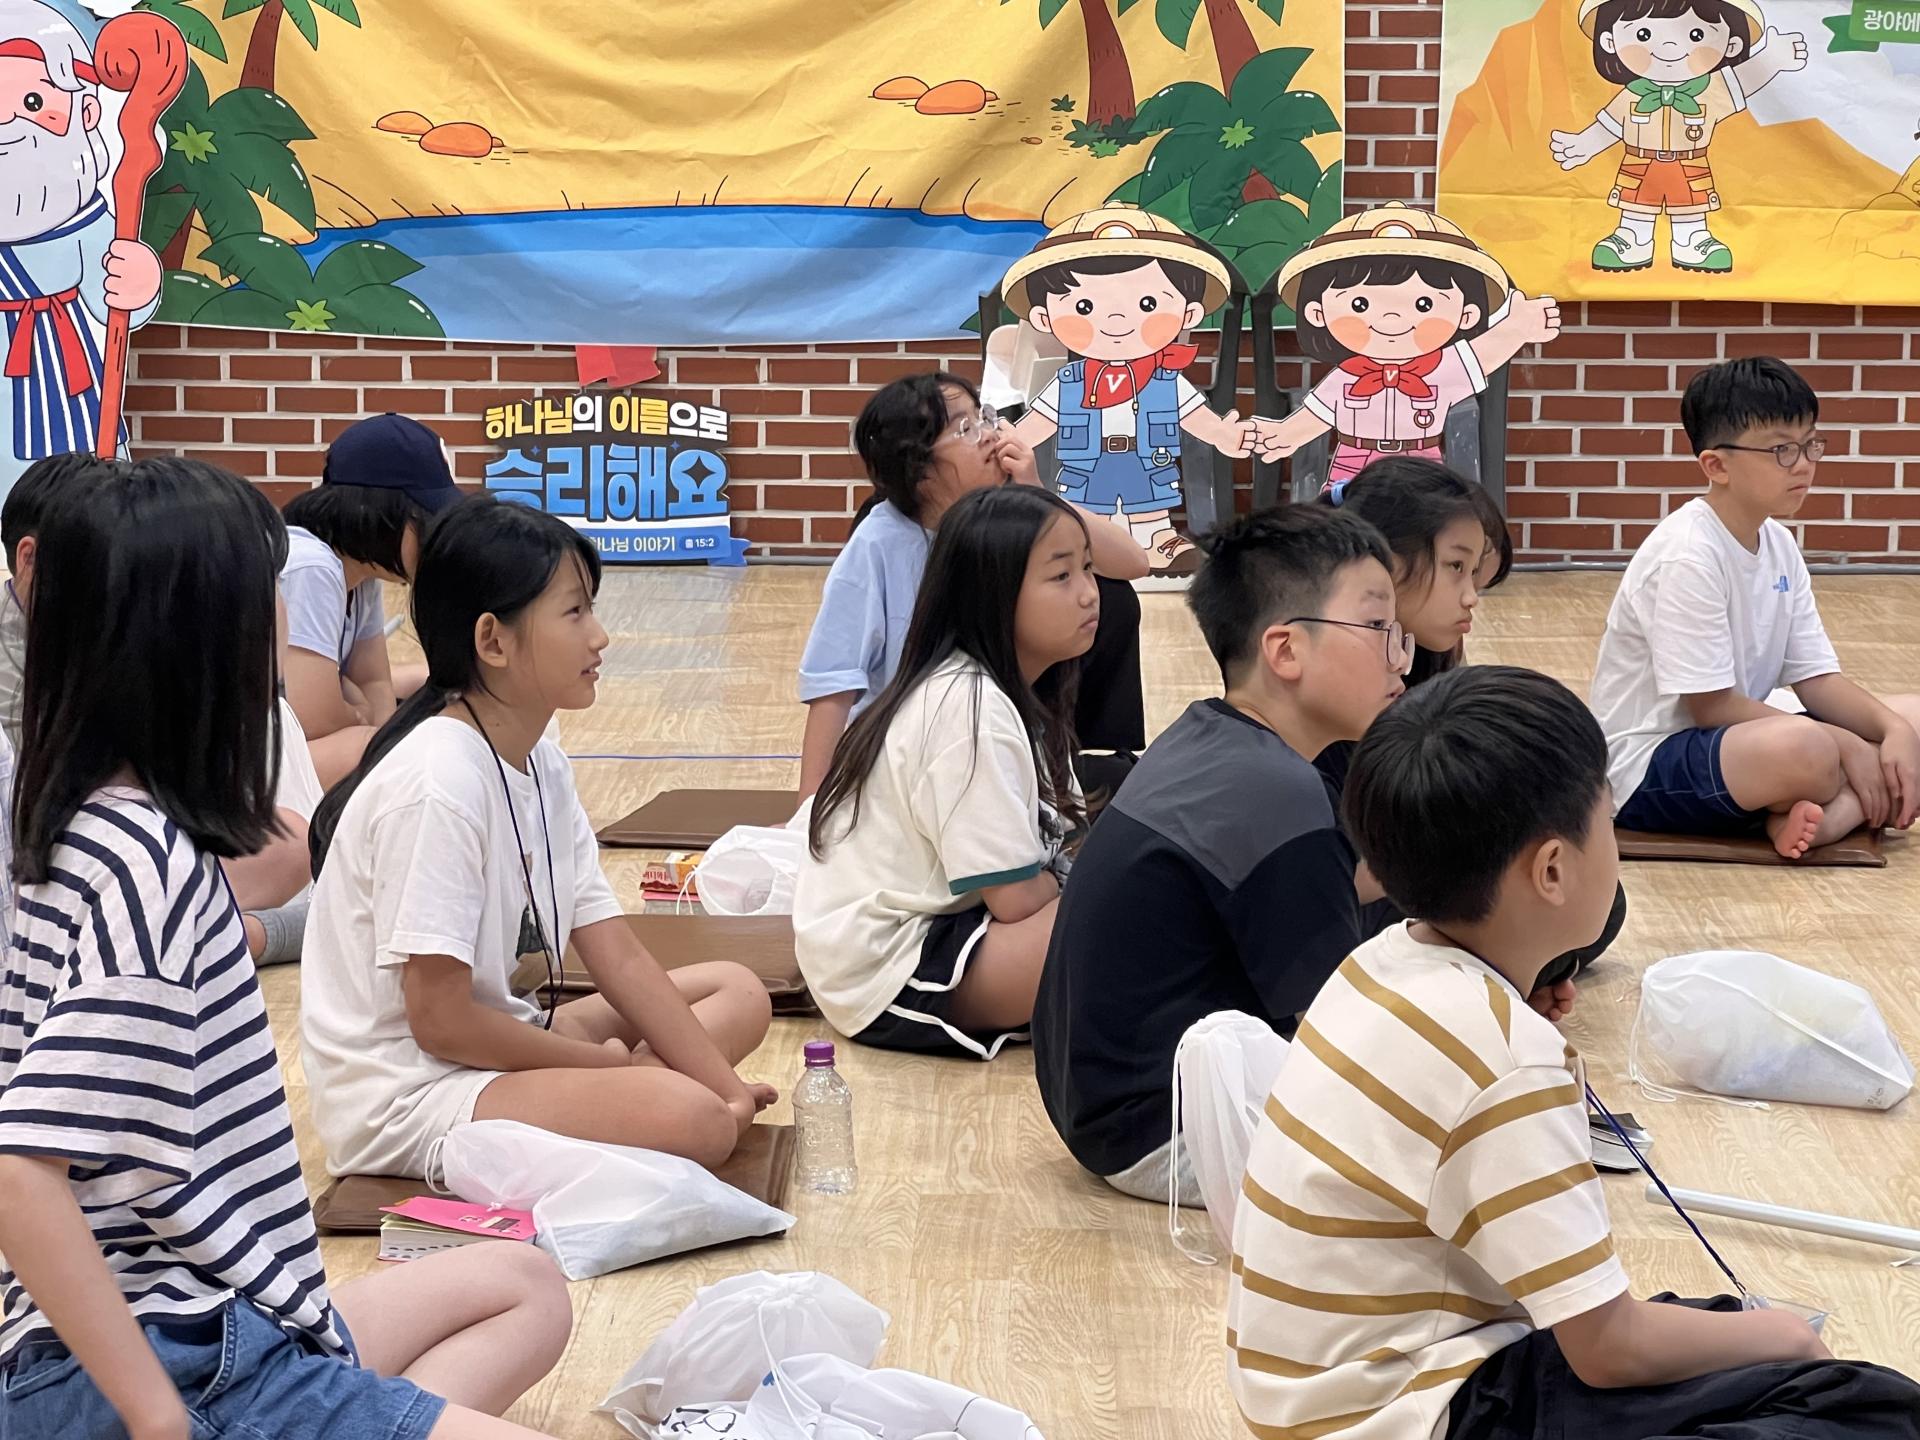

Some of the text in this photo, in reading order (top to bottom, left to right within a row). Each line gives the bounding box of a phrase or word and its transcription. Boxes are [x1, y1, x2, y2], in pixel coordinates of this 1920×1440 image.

[1864, 9, 1920, 32] 광야에
[1663, 91, 1674, 101] V
[1105, 374, 1127, 394] V
[1386, 370, 1398, 382] V
[486, 396, 728, 441] 하나님의 이름으로
[486, 443, 728, 519] 승리해요
[634, 537, 675, 551] 이야기
[695, 538, 715, 548] 15:2
